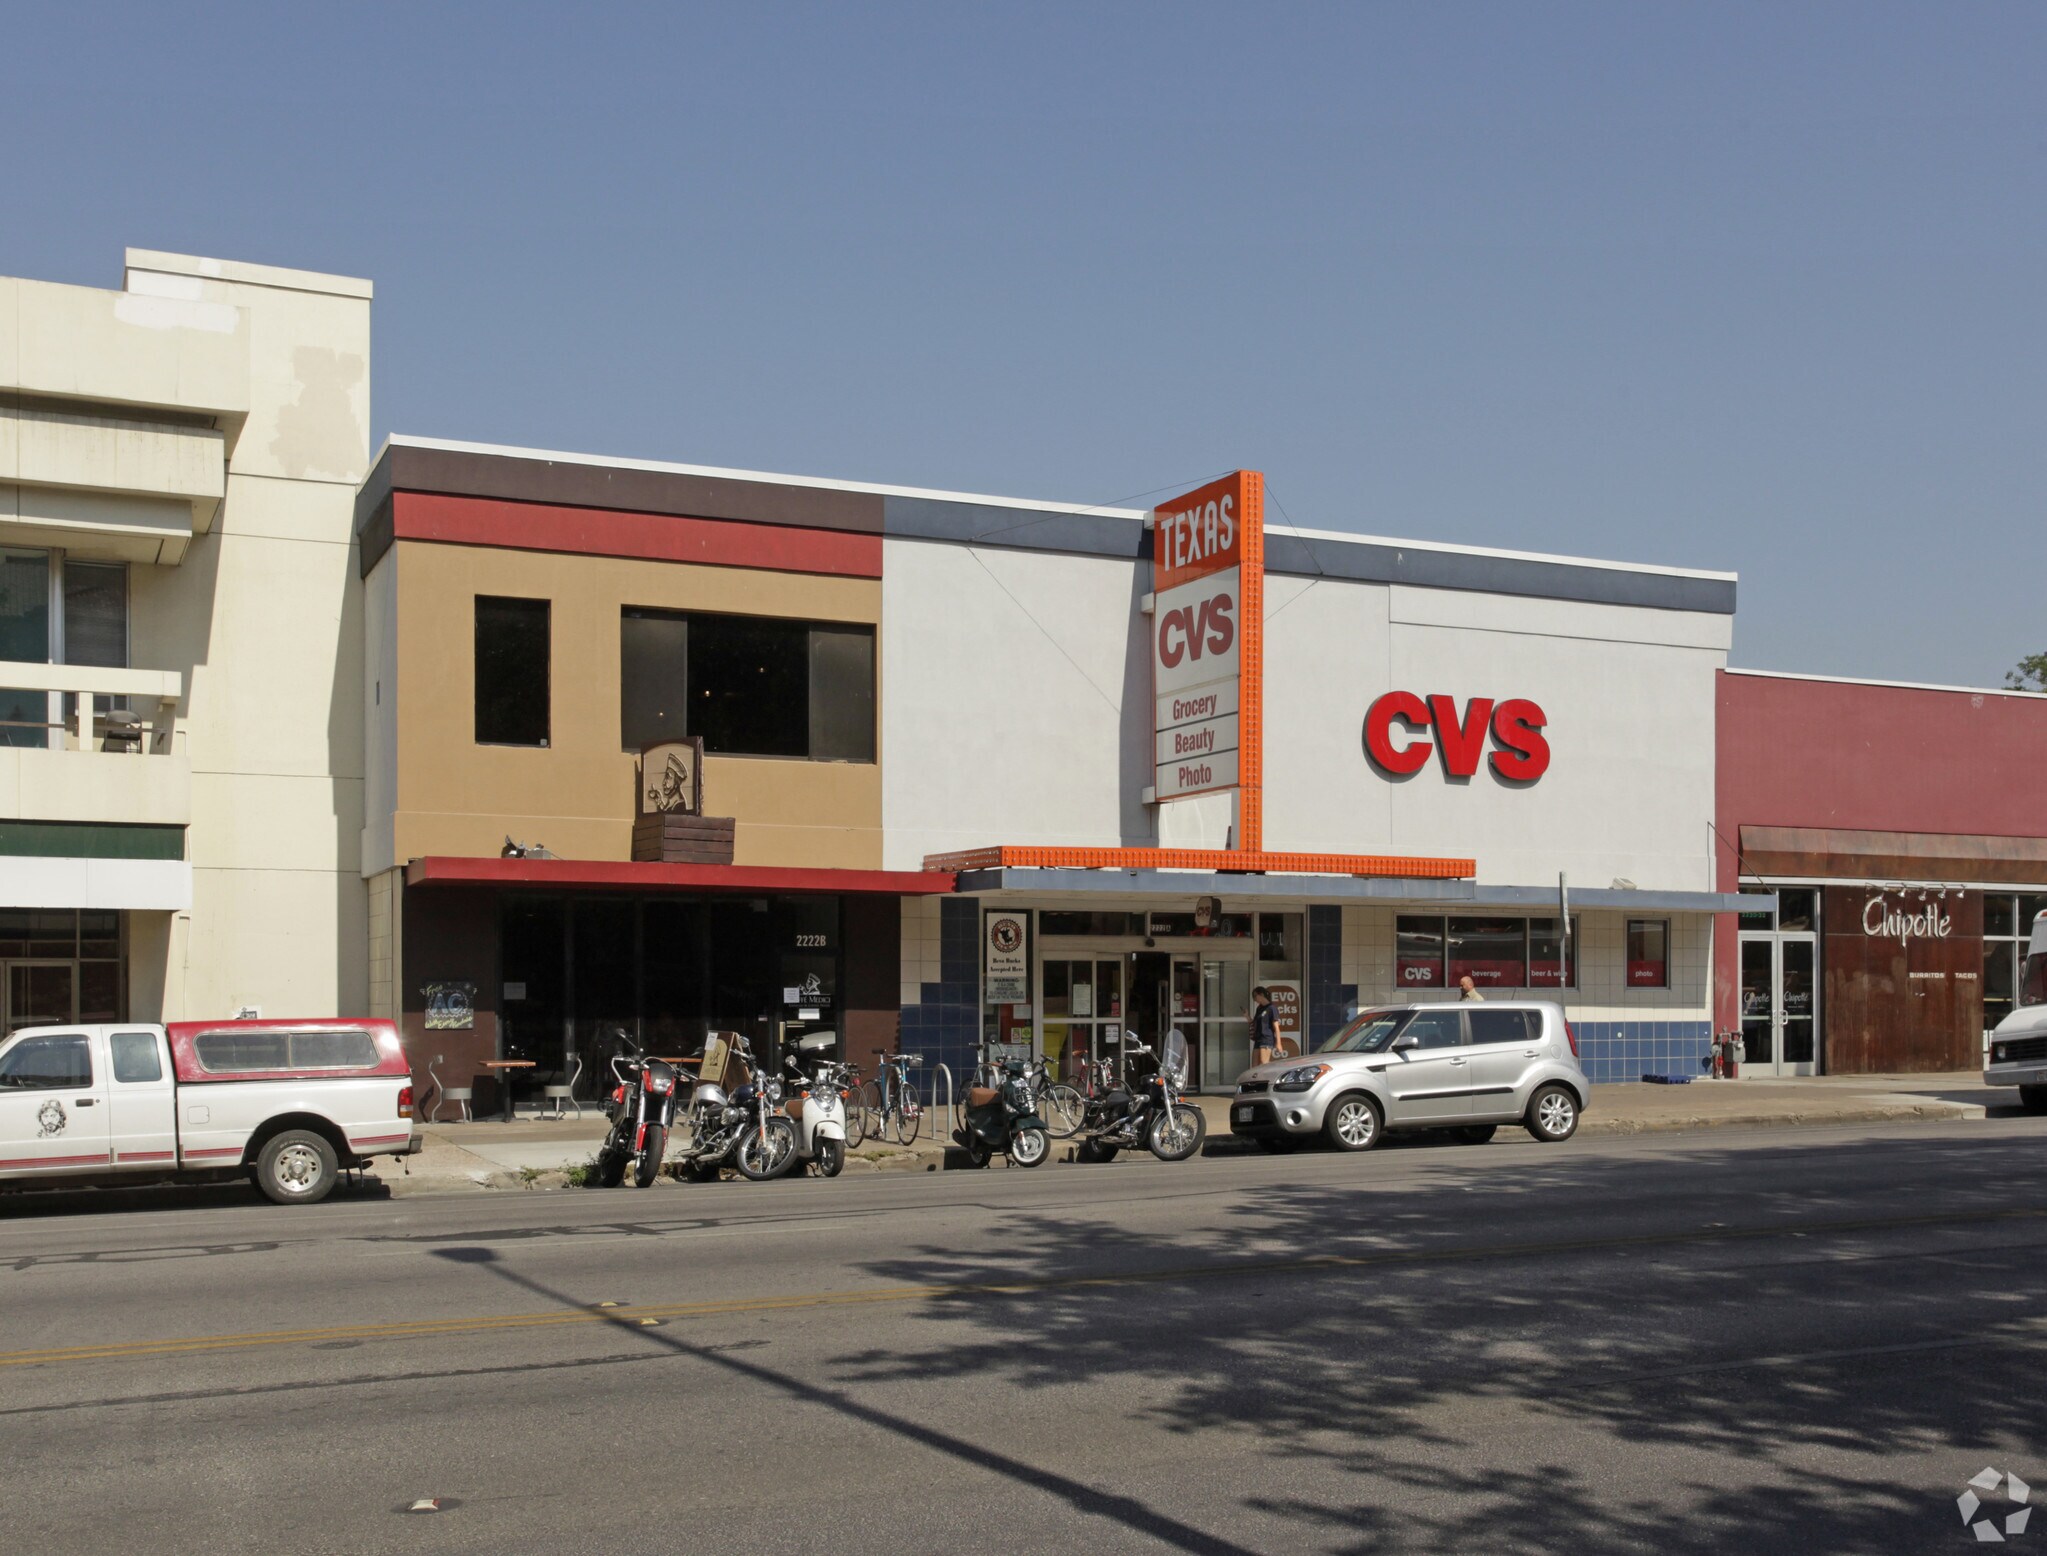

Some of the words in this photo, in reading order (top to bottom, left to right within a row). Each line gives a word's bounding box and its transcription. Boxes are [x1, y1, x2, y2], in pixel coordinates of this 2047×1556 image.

[1160, 494, 1234, 572] TEXAS
[1158, 593, 1234, 669] CVS
[1172, 694, 1217, 721] Grocery
[1174, 728, 1215, 754] Beauty
[1363, 690, 1551, 781] CVS
[1178, 765, 1212, 788] Photo
[1196, 906, 1211, 917] CVS
[1862, 896, 1952, 948] Chipotle
[796, 934, 827, 947] 2222B
[1404, 967, 1432, 980] CVS
[1471, 970, 1501, 979] beverage
[431, 993, 464, 1014] AC
[1271, 992, 1296, 1002] EVO
[1277, 1004, 1298, 1014] cks
